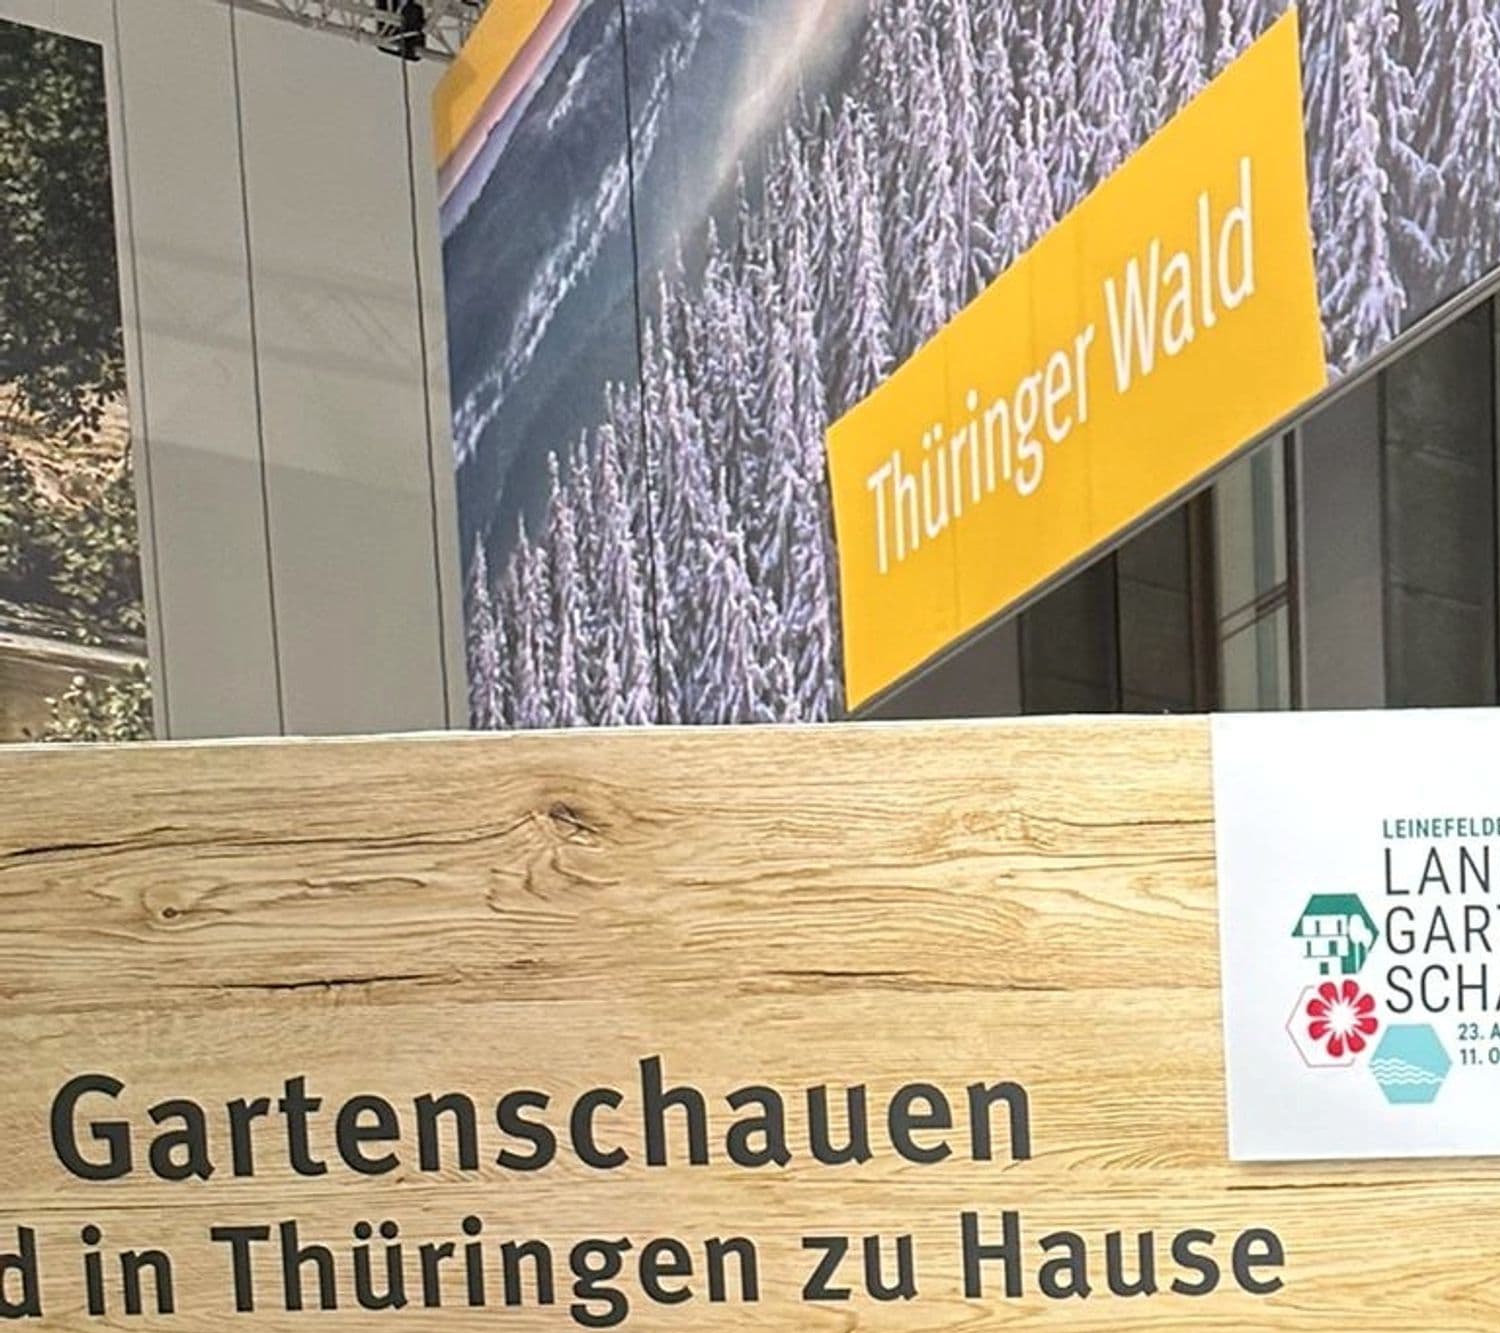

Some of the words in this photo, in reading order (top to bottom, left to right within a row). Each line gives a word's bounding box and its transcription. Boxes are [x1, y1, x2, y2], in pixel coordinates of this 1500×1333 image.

[866, 324, 1096, 576] Thüringer
[1104, 157, 1256, 394] Wald
[1457, 1022, 1485, 1041] 23.
[1459, 1047, 1483, 1065] 11.
[51, 1056, 1030, 1181] Gartenschauen
[82, 1225, 174, 1316] in
[211, 1215, 758, 1328] Thüringen
[803, 1235, 916, 1301] zu
[962, 1212, 1284, 1298] Hause
